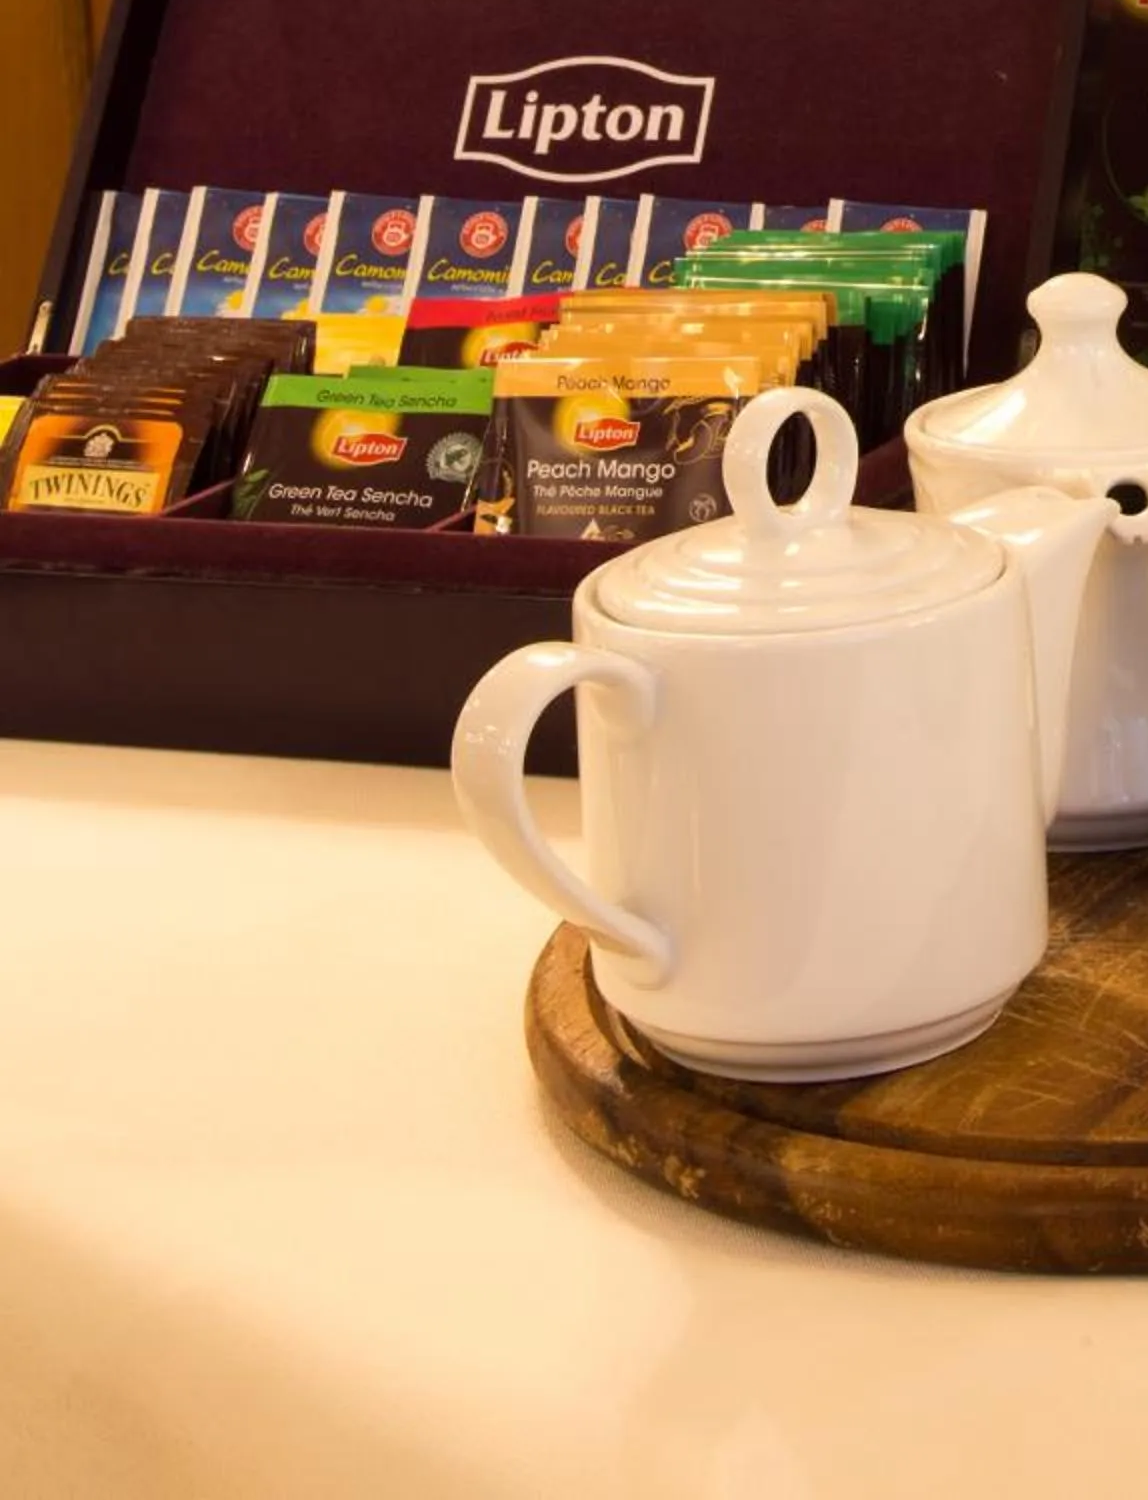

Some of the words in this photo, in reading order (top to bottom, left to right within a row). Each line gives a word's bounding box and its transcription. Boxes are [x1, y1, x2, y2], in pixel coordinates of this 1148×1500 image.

[482, 90, 685, 154] Lipton
[557, 376, 609, 391] Peach
[612, 375, 671, 393] Mango
[316, 389, 364, 406] Green
[368, 392, 395, 409] Tea
[399, 393, 457, 408] Sencha
[578, 425, 634, 442] Lipton
[337, 438, 399, 456] Lipton
[527, 459, 590, 479] Peach
[598, 460, 675, 483] Mango
[29, 467, 147, 508] TWININGS
[268, 483, 322, 500] Green
[326, 485, 358, 502] Tea
[361, 487, 433, 508] Sencha
[533, 485, 556, 497] Thé
[559, 485, 601, 498] Pêche
[605, 485, 663, 500] Mangue
[290, 503, 314, 516] Thé
[316, 504, 342, 518] Vert
[344, 506, 396, 521] Sencha
[598, 505, 633, 516] BLACK
[636, 505, 655, 516] TEA
